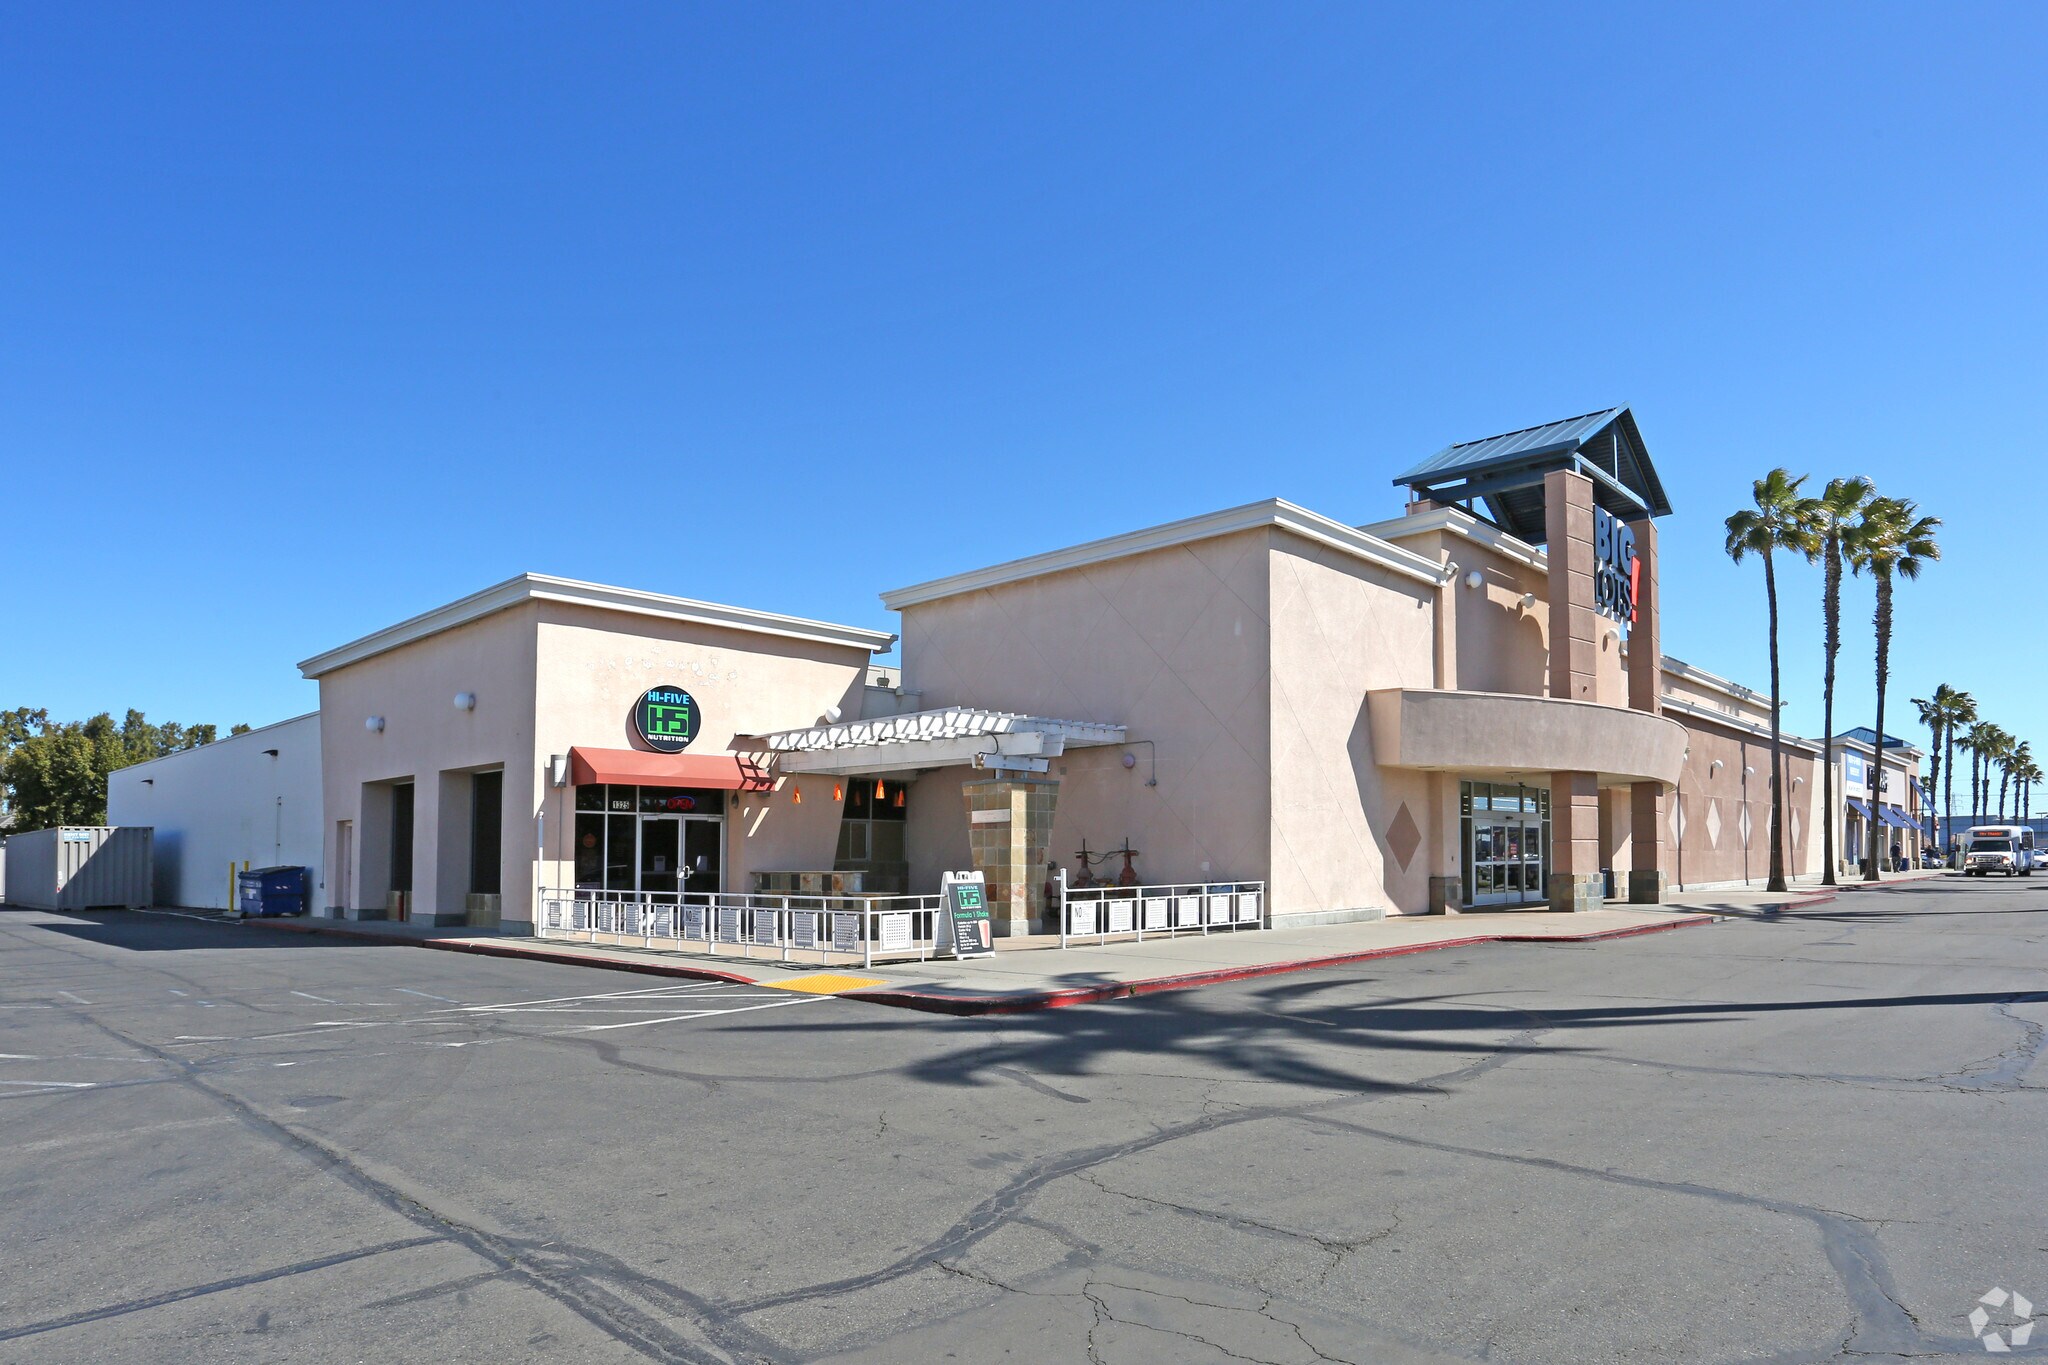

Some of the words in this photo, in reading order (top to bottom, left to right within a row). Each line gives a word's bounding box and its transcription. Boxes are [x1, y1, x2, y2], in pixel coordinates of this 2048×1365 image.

[1594, 505, 1637, 576] BIG
[647, 691, 690, 705] HI-FIVE
[647, 734, 689, 743] NUTRITION
[667, 799, 694, 810] OPEN
